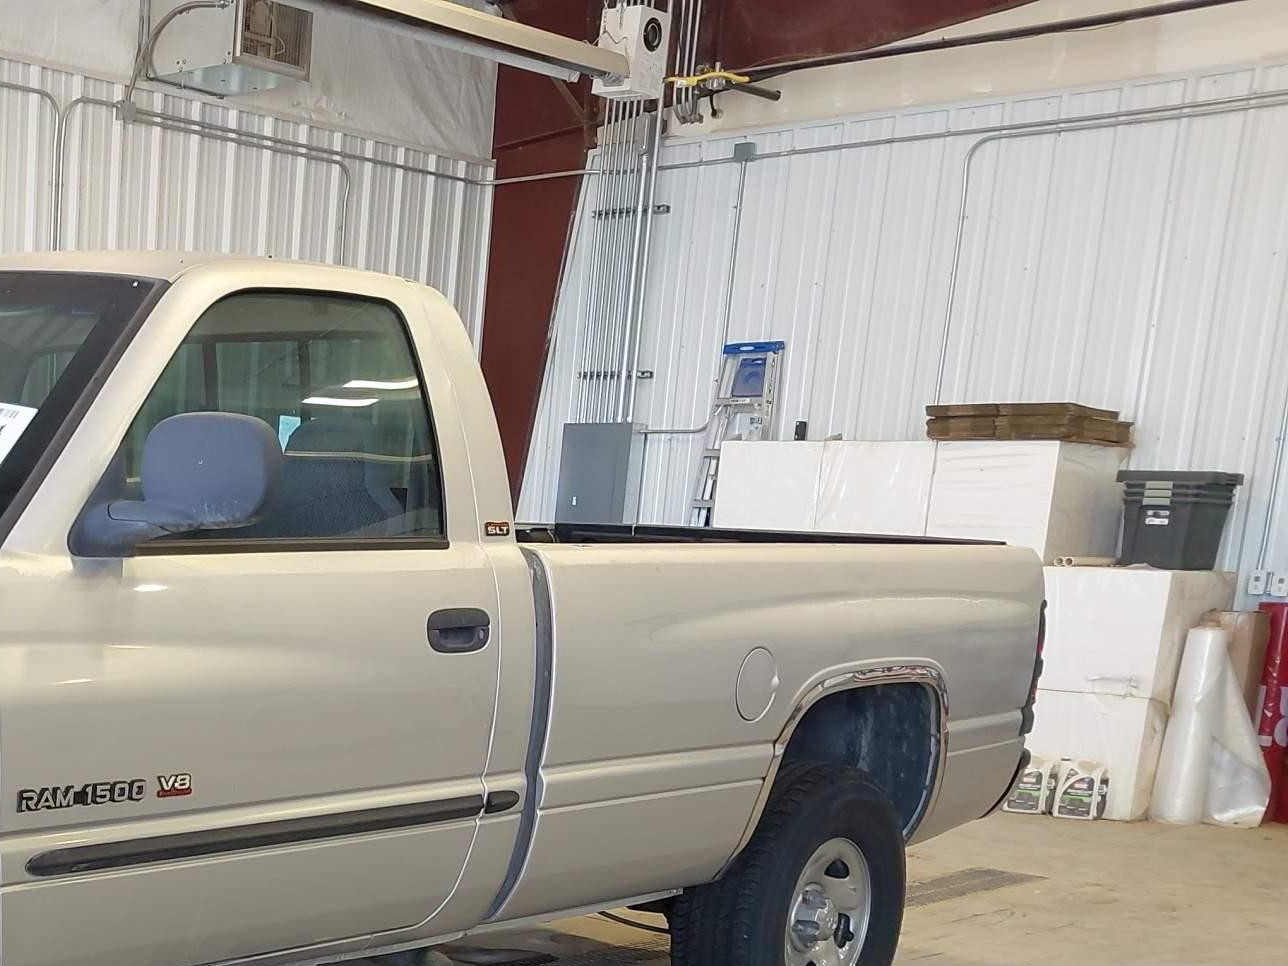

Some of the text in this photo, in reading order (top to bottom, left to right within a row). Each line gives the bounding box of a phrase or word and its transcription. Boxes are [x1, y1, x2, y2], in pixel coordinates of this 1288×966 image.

[487, 526, 509, 535] SLT
[16, 773, 192, 813] RAM 1500 V8
